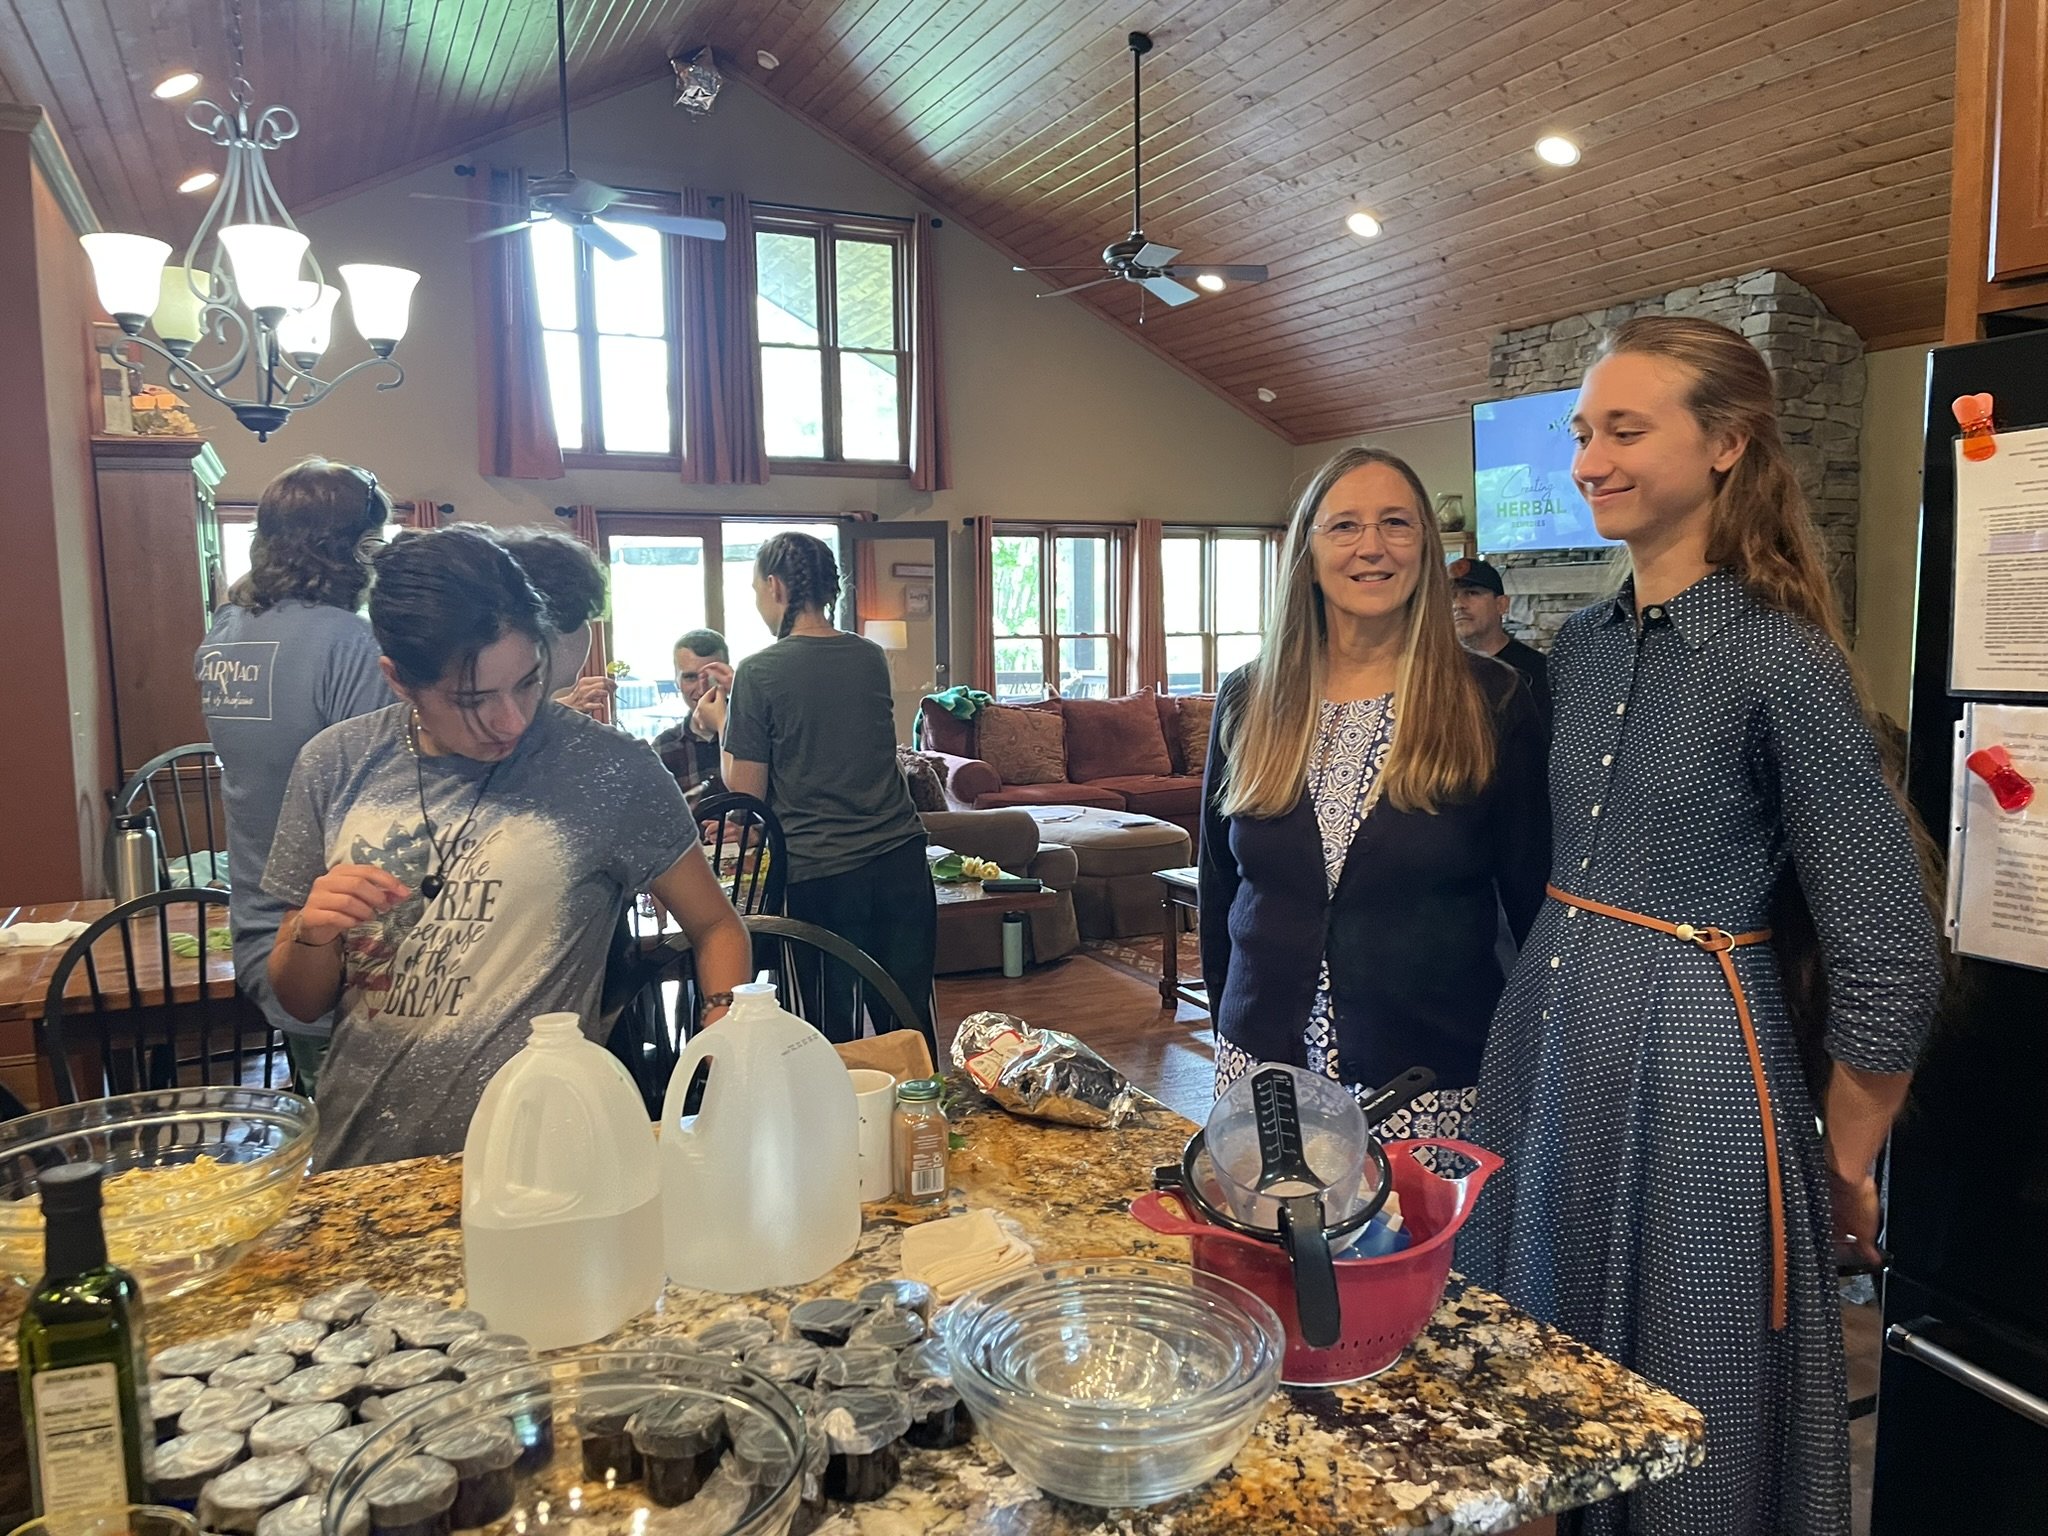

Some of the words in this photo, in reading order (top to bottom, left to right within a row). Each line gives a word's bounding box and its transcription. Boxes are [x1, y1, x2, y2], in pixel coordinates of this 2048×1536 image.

[1496, 498, 1567, 518] HERBAL
[433, 879, 503, 922] REE
[425, 944, 462, 978] the
[384, 973, 471, 1018] BRAVE
